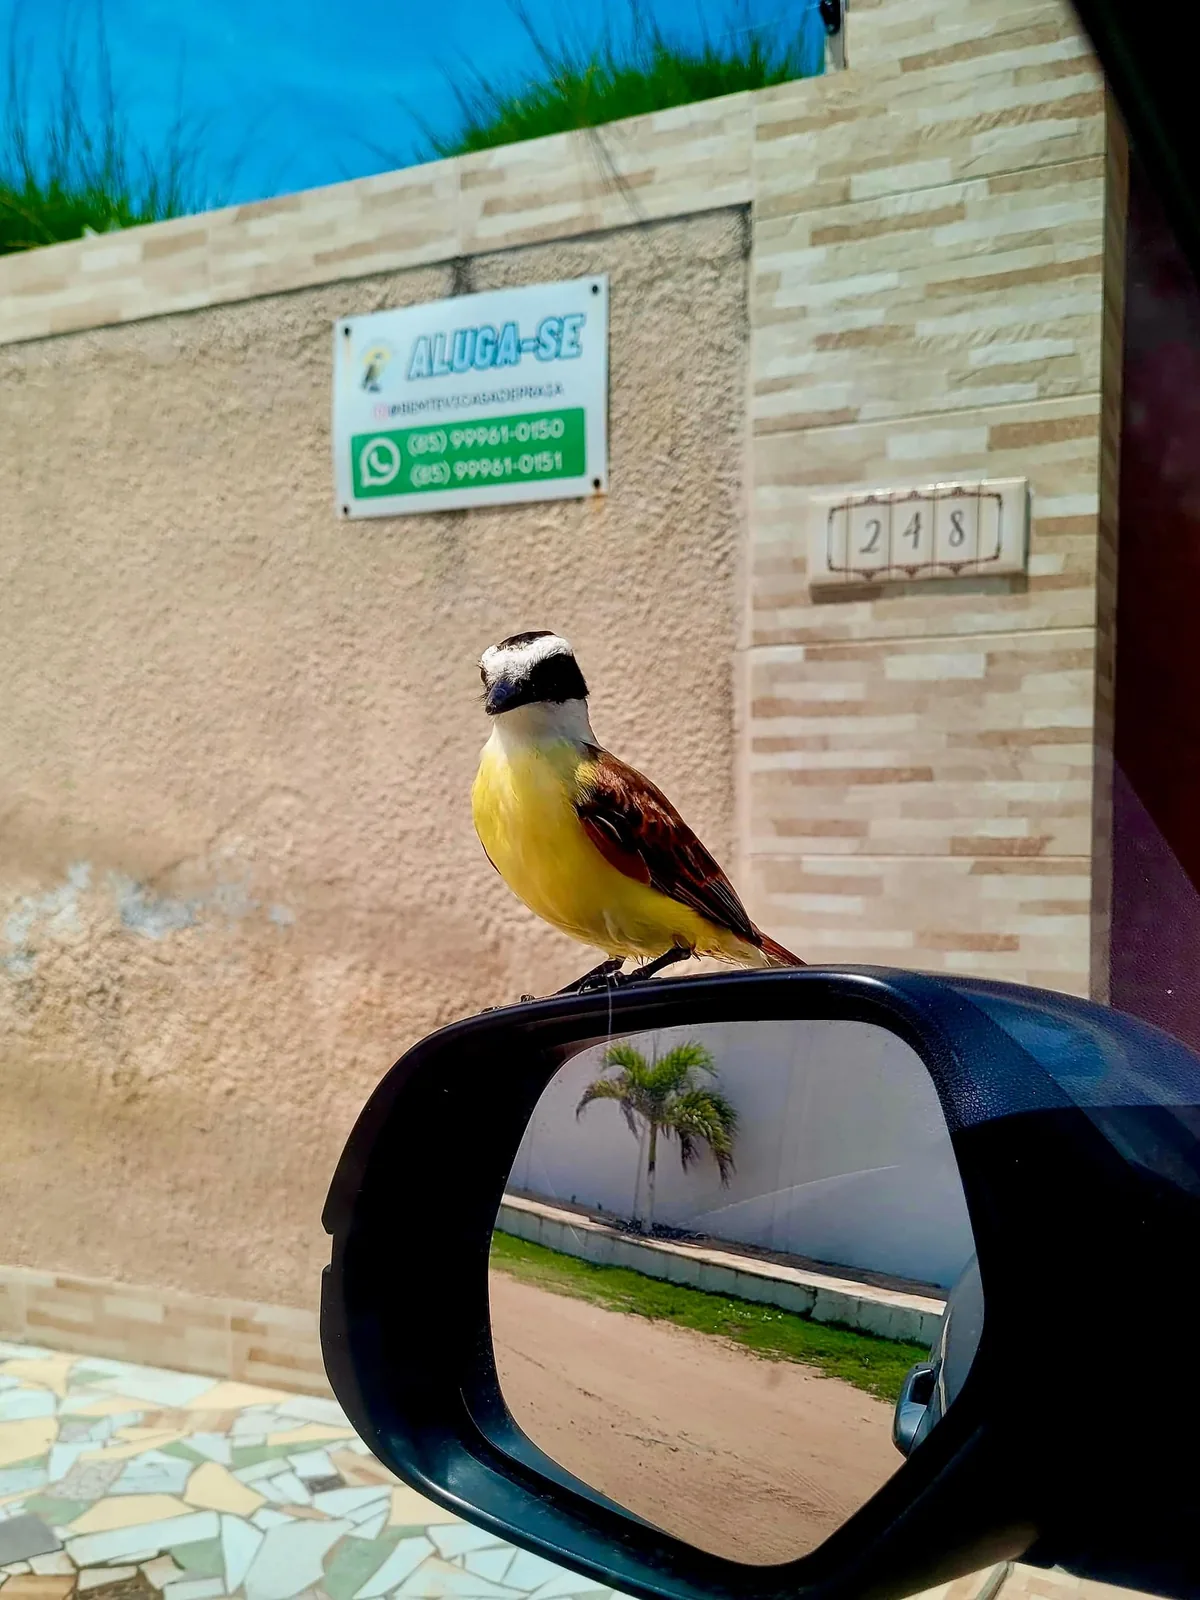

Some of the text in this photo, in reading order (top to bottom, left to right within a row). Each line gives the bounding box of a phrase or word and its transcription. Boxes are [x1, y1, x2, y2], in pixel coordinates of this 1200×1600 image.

[406, 313, 585, 380] ALUGA-SE
[407, 418, 565, 457] (85) 99961-0150
[410, 451, 563, 488] (85) 99961-0151
[859, 510, 965, 553] 248
